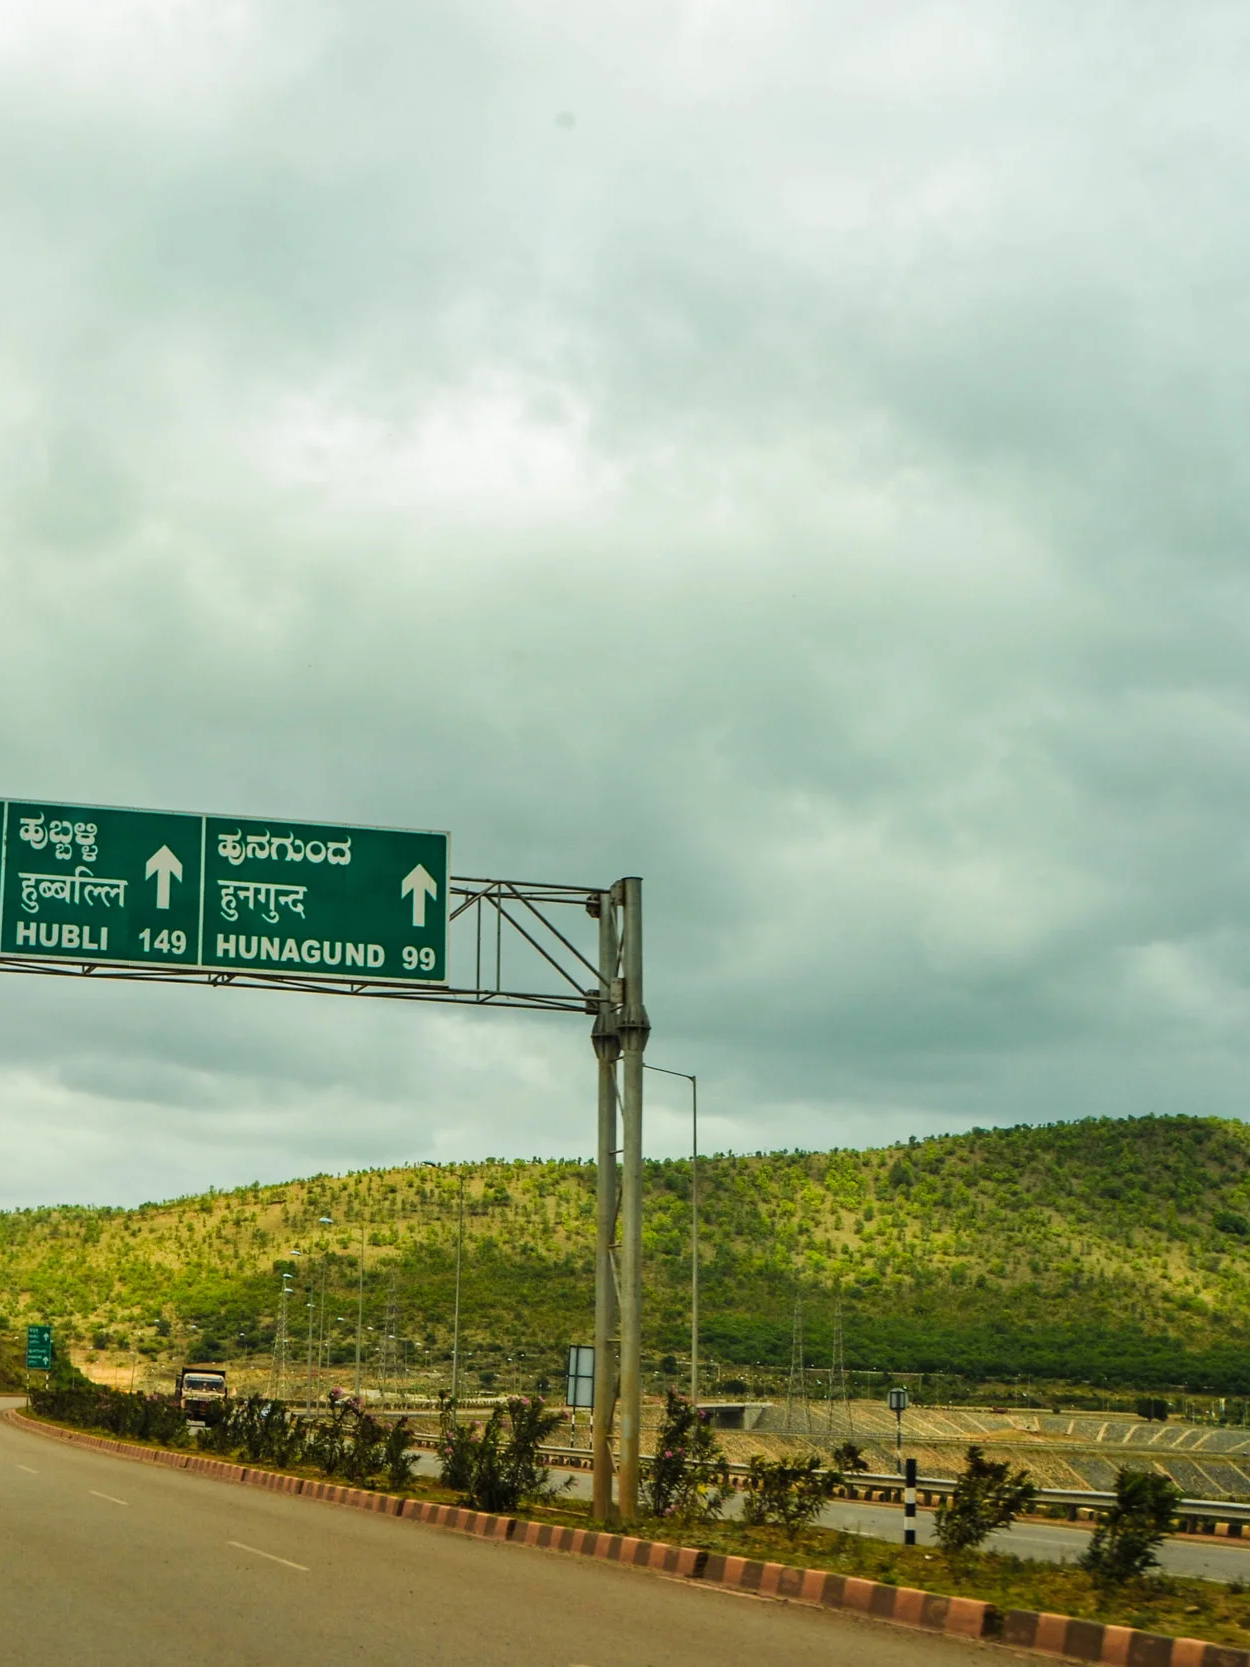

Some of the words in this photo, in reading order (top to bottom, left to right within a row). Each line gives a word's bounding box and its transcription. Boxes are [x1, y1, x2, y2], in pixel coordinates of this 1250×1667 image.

[19, 812, 98, 862] ಹುಬ್ಬಳ್ಳಿ
[217, 829, 352, 866] ಹುನಗುಂದ
[217, 879, 308, 924] हुनगुन्द
[16, 921, 108, 951] HUBLI
[139, 928, 187, 955] 149
[216, 933, 385, 968] HUNAGUND
[402, 946, 436, 971] 99
